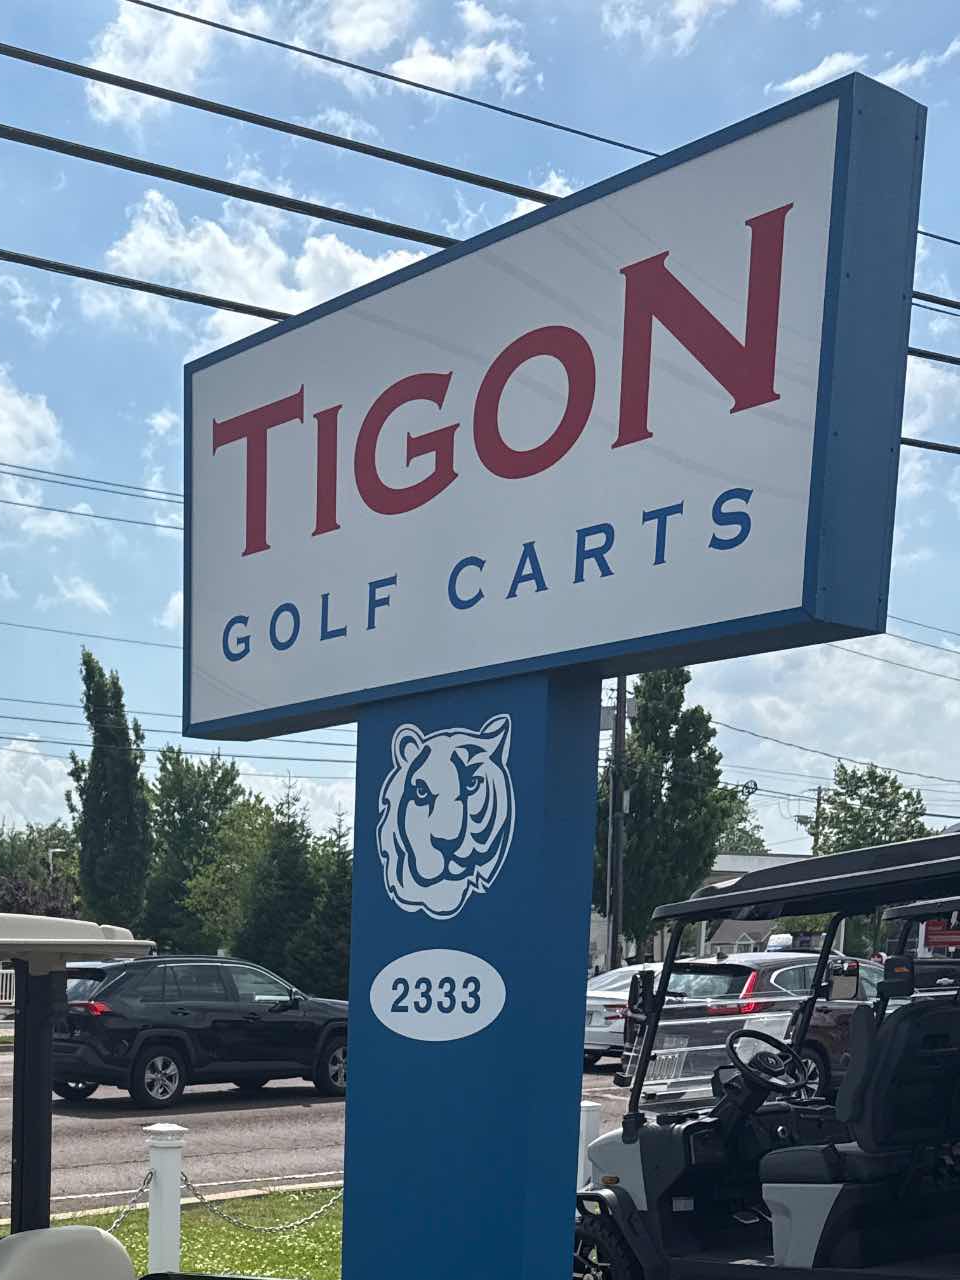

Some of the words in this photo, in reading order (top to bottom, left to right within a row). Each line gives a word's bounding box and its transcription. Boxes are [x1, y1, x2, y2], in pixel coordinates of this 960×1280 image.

[212, 202, 794, 557] TIGON
[222, 575, 397, 662] GOLF
[448, 488, 753, 610] CARTS
[391, 976, 481, 1014] 2333
